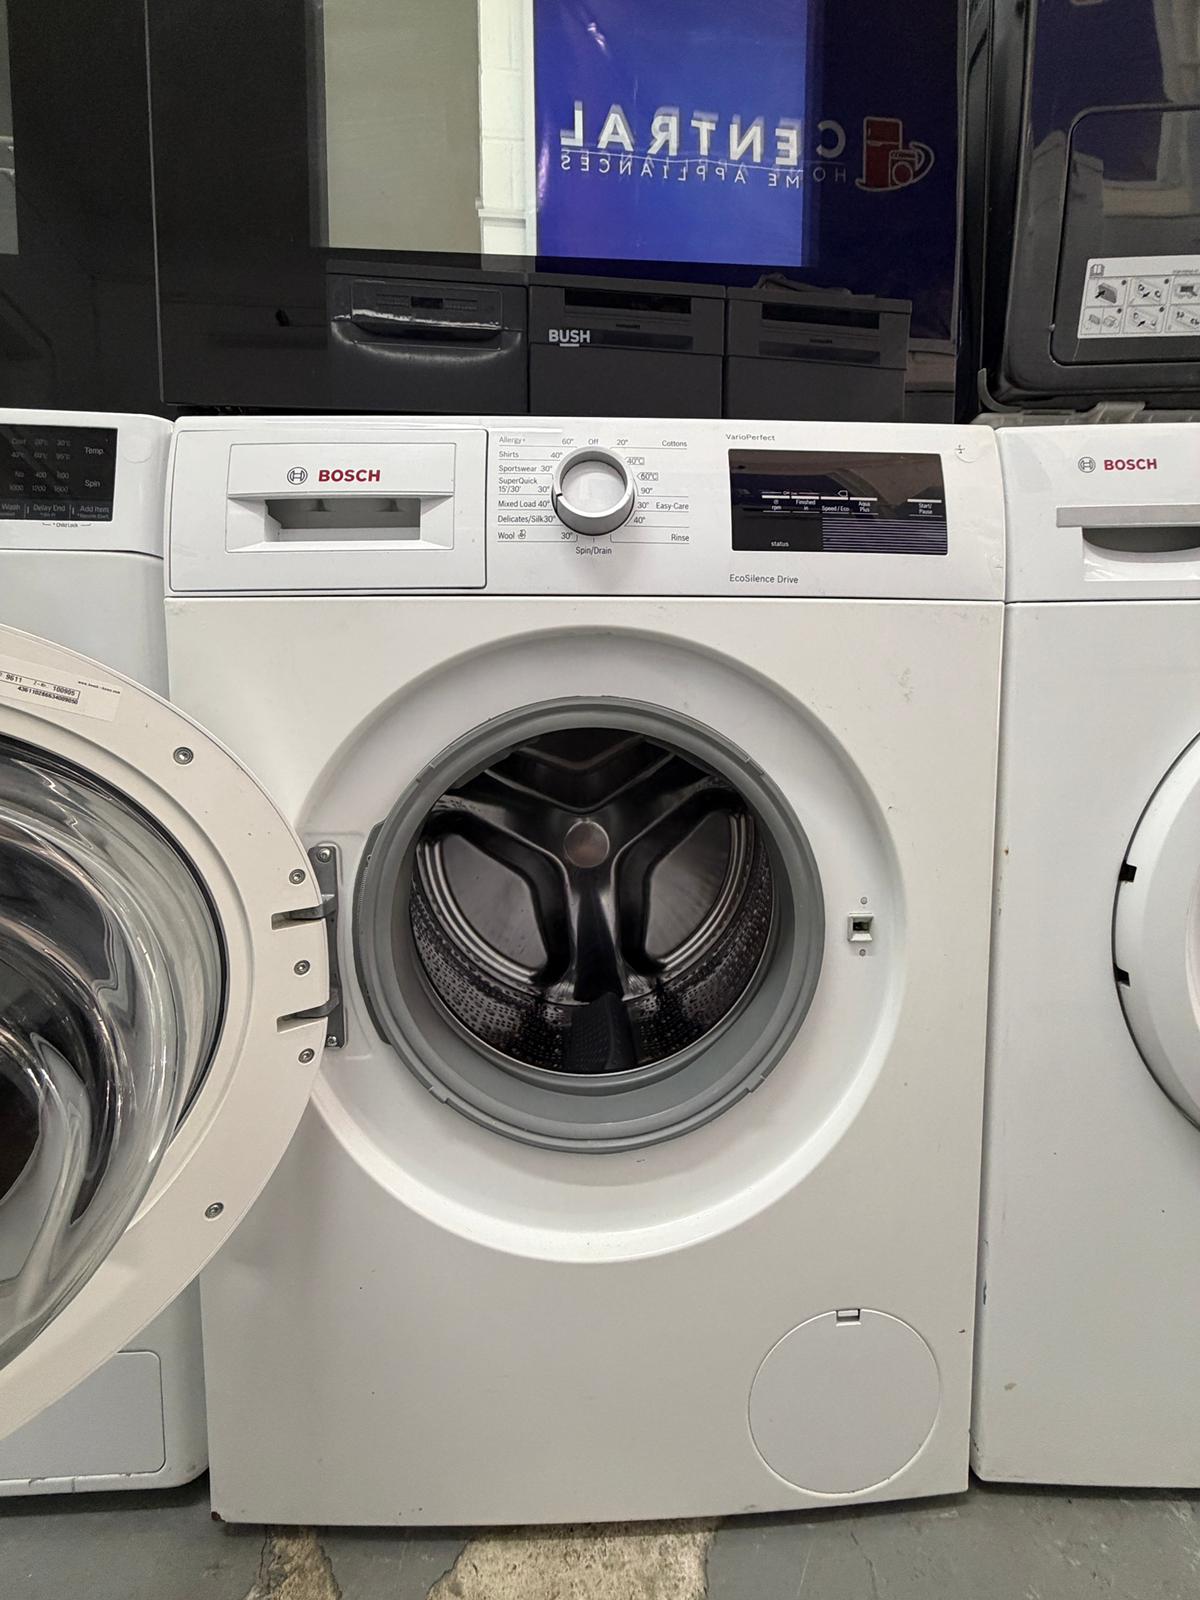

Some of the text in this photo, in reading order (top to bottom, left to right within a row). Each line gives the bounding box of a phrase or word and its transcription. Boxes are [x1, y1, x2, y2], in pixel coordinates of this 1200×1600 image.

[548, 328, 591, 344] BUSH
[725, 433, 776, 442] VarioPerfect
[616, 438, 688, 447] 20° Cottons
[85, 446, 105, 456] Temp.
[498, 450, 520, 458] Shirts
[498, 464, 538, 473] Sportswear
[1103, 458, 1158, 471] BOSCH
[318, 469, 381, 482] BOSCH
[84, 479, 101, 488] Spin
[498, 477, 538, 485] SuperQuick
[33, 503, 52, 512] Delay
[498, 500, 518, 508] Mixed
[520, 500, 537, 508] Load
[637, 501, 649, 509] 30°
[79, 505, 93, 513] Add
[497, 515, 543, 524] Delicates/Silk
[633, 516, 646, 524] 40°
[497, 531, 573, 540] Wool 30°
[671, 533, 690, 542] Rinse
[575, 546, 613, 556] Spin/Drain
[729, 573, 799, 584] EcoSilence Drive
